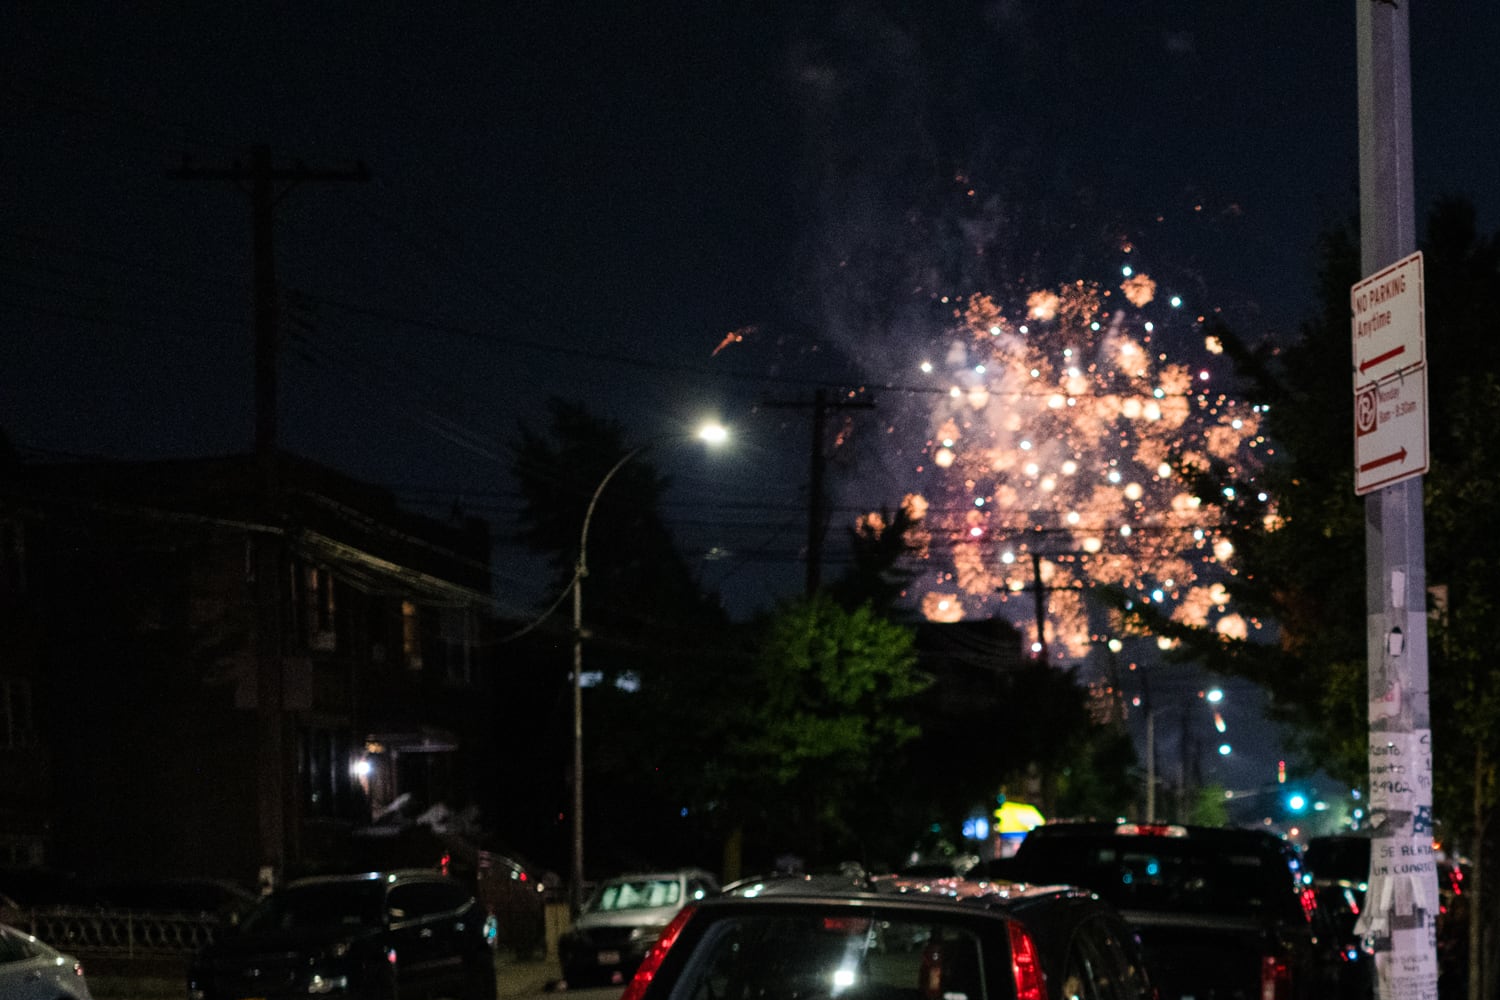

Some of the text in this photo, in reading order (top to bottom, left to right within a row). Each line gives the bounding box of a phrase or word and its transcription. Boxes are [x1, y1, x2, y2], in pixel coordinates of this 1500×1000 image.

[1356, 273, 1406, 314] NO PARKING
[1357, 309, 1392, 338] Anytime
[1393, 861, 1434, 874] CUARTO
